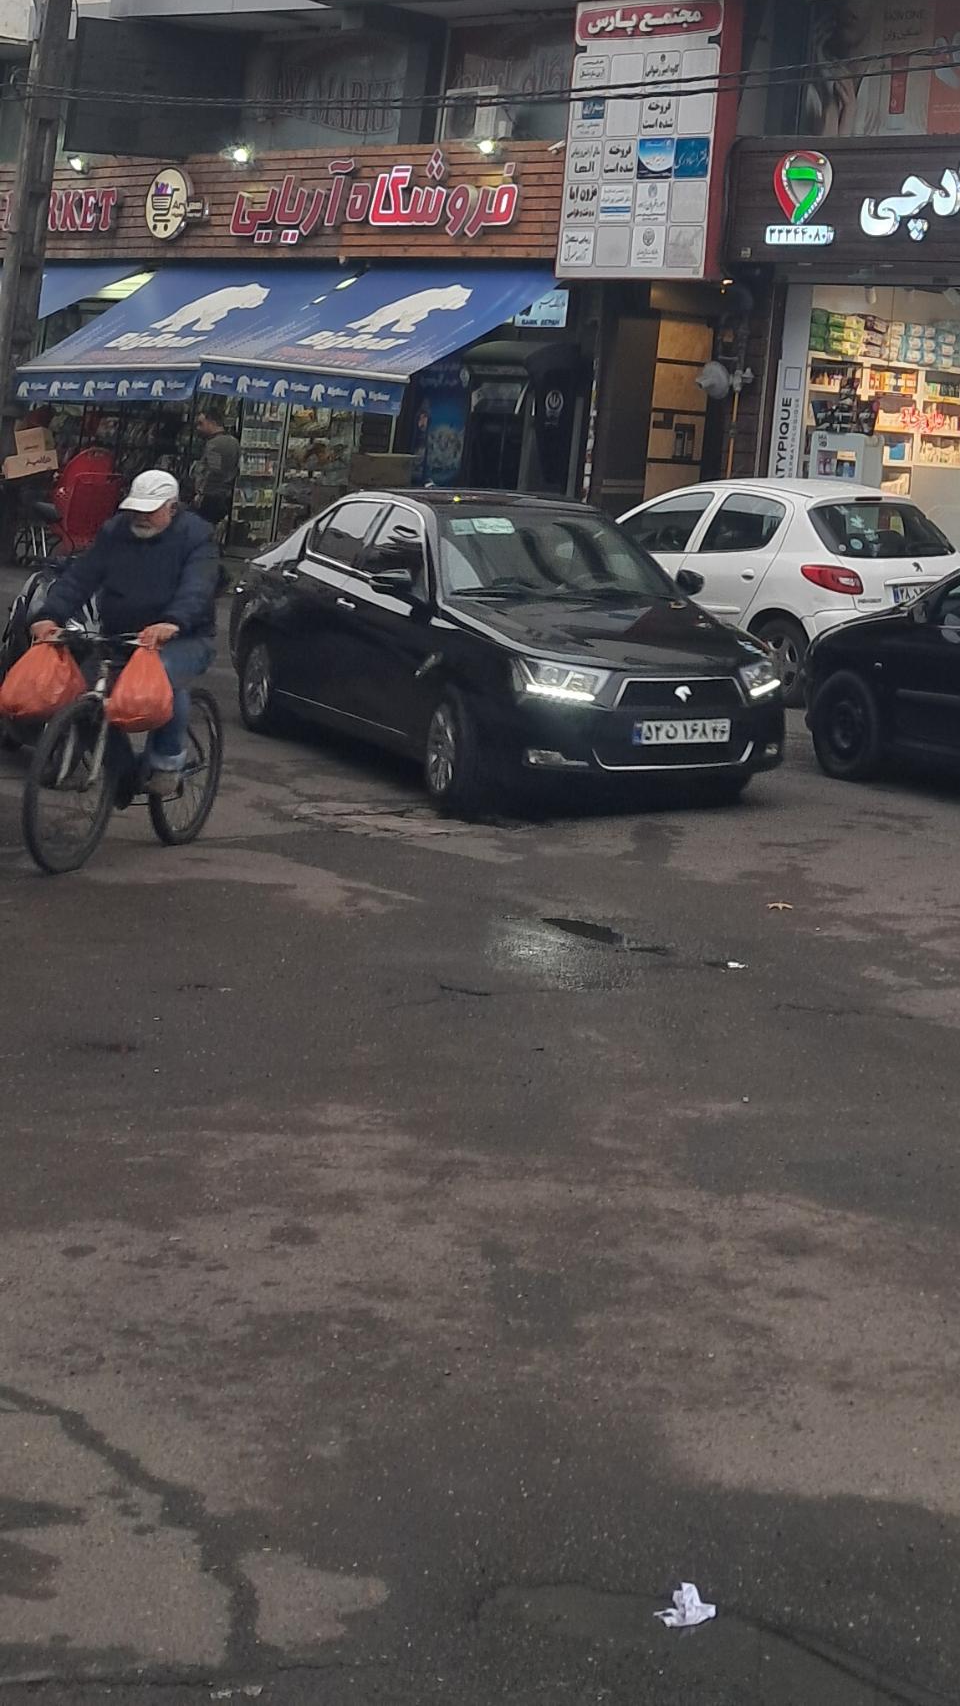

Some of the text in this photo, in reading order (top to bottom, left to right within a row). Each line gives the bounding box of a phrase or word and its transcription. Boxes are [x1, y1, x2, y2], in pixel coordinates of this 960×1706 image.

[587, 7, 702, 36] مجتمع پارس
[229, 149, 521, 245] فروشگاه آریایی
[775, 397, 793, 479] TYPIQUE
